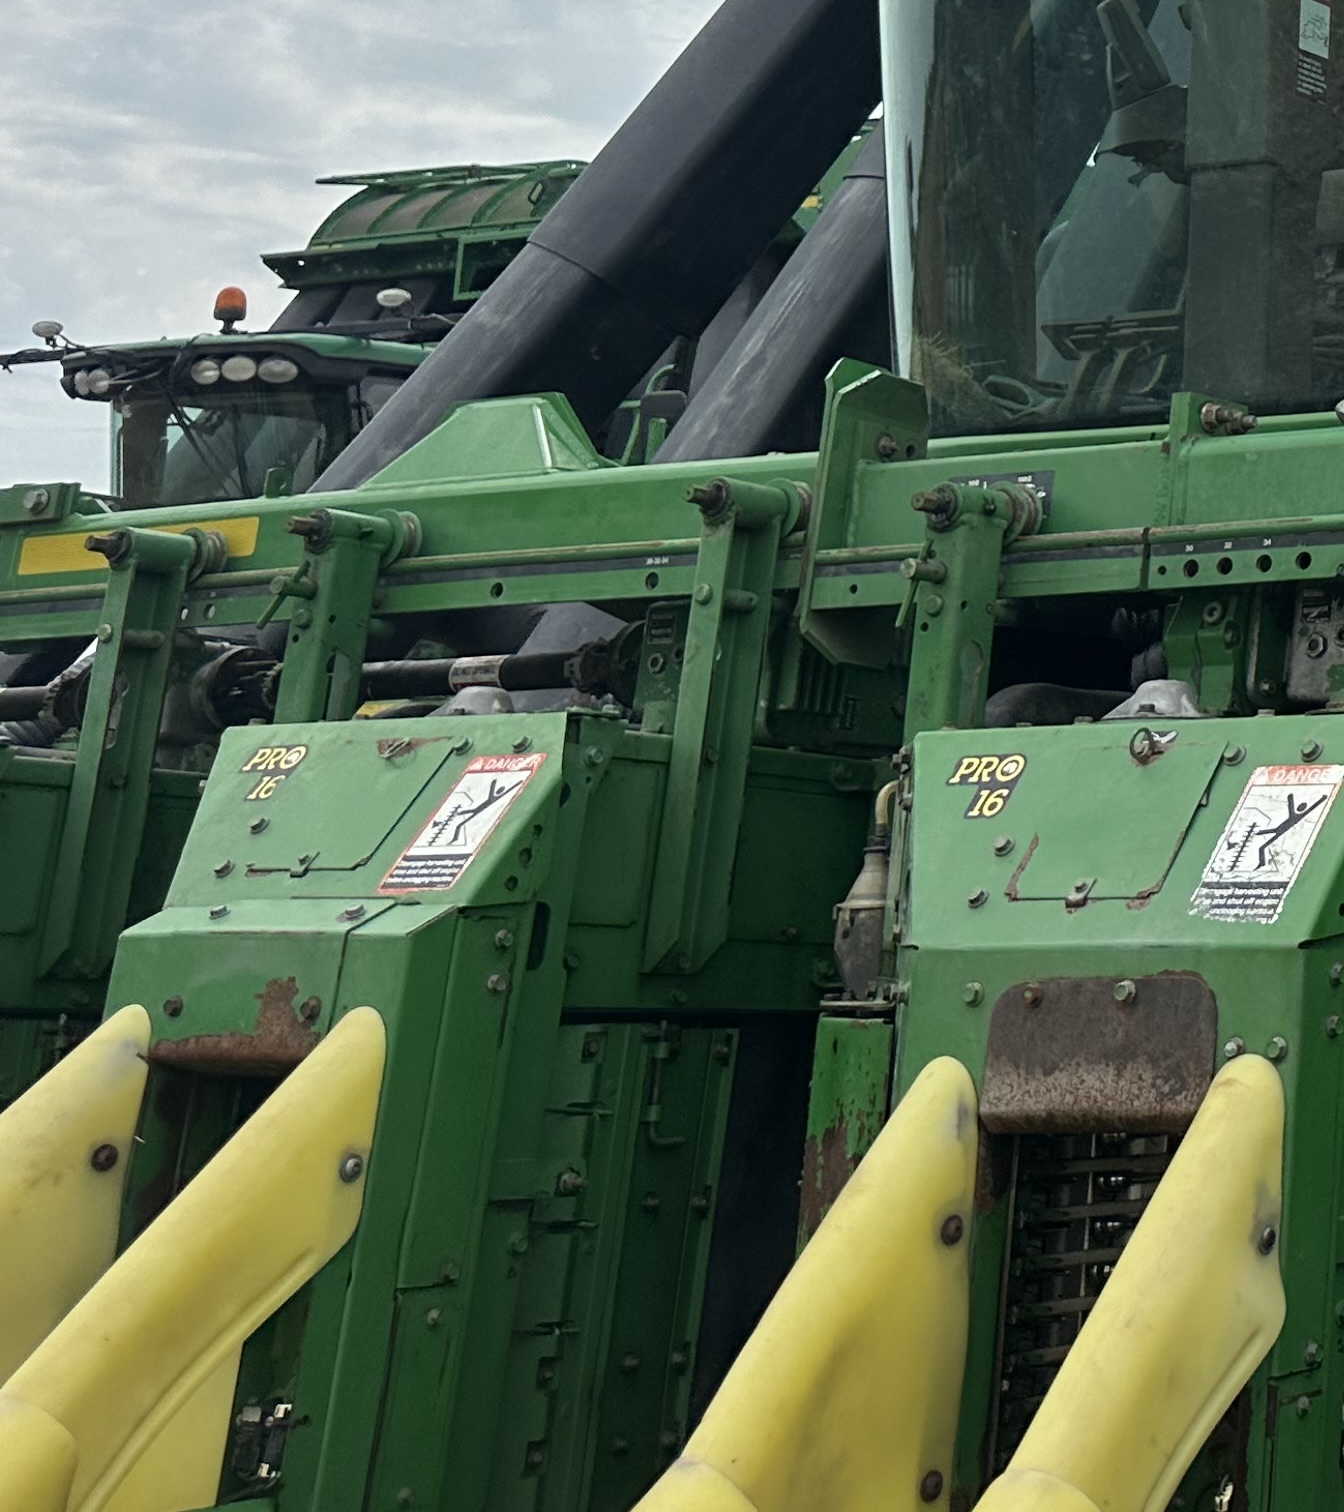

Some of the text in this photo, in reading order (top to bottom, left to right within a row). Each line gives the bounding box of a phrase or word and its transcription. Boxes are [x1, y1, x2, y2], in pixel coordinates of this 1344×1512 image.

[242, 745, 306, 771] PRO
[948, 755, 1025, 783] PRO
[247, 775, 286, 799] 16
[1272, 767, 1341, 785] DANGE
[967, 788, 1010, 817] 16
